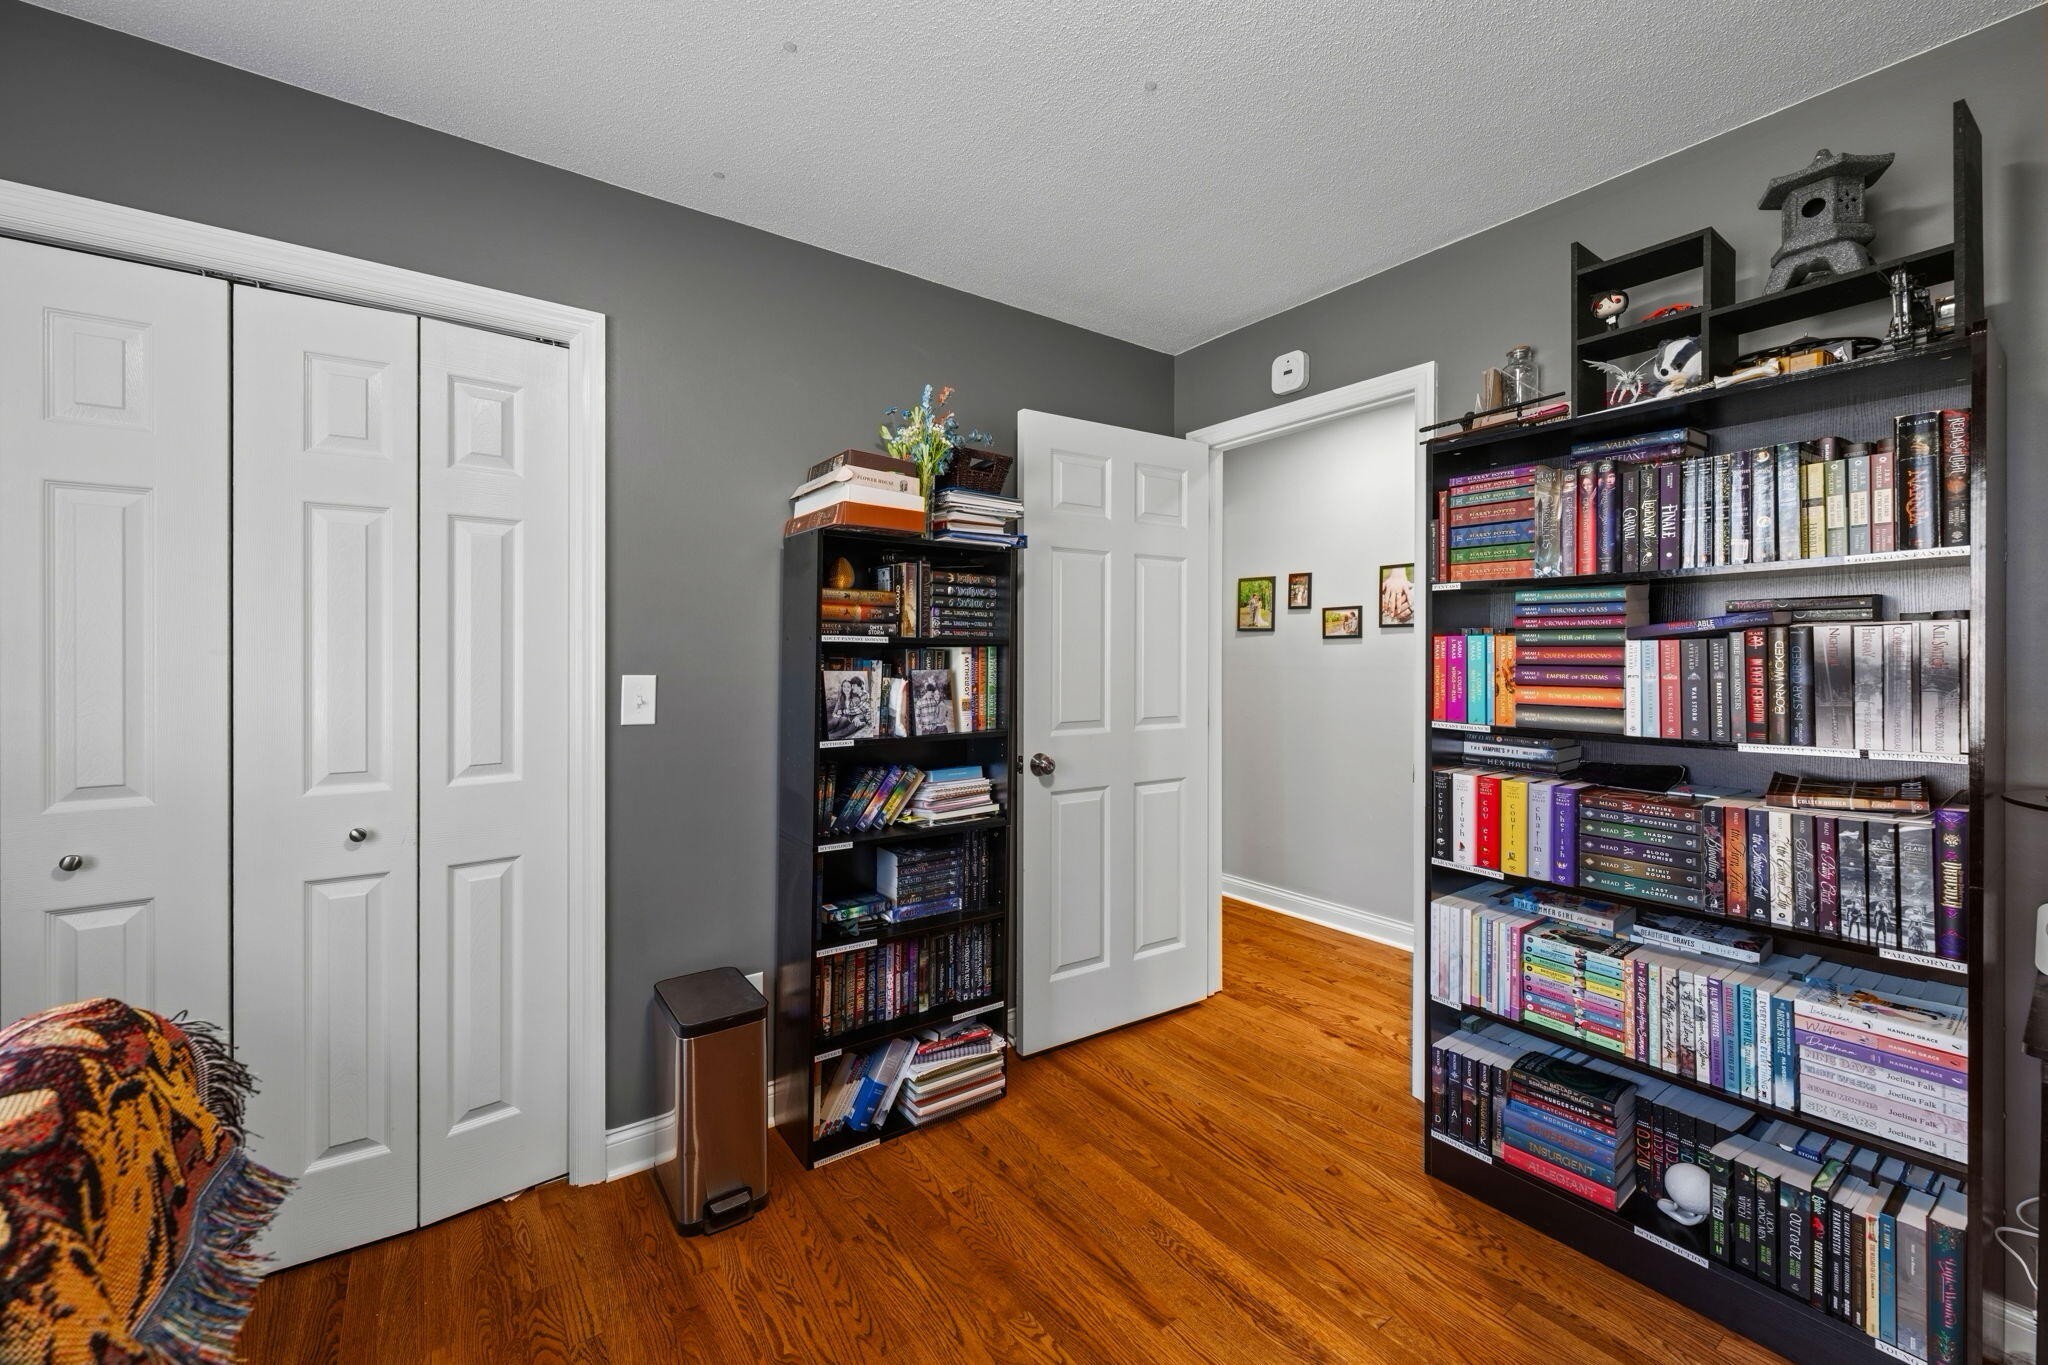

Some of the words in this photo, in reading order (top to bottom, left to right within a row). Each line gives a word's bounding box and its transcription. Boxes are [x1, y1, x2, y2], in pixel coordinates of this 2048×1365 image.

[1914, 417, 1936, 425] LEWIS
[1606, 438, 1646, 449] VALIANT
[1949, 454, 1966, 476] LIGHT
[1662, 504, 1678, 539] FINALE
[1775, 640, 1784, 687] WICKED
[1792, 645, 1802, 678] CURSED
[1775, 690, 1785, 715] BORN
[1793, 678, 1802, 709] STAR
[1482, 745, 1505, 753] VAMPIRE'S
[1508, 761, 1531, 769] HALL
[1638, 809, 1676, 817] ACADEMY
[1534, 807, 1542, 852] charm
[1640, 819, 1678, 828] FROSTBITE
[1644, 832, 1673, 840] SHADOW
[1643, 854, 1673, 862] PROMISE
[1642, 890, 1678, 900] SACRIFICE
[1530, 904, 1556, 915] SUMMER
[1558, 910, 1574, 920] GIRL
[1640, 928, 1670, 942] BEAUTIFUL
[1672, 937, 1696, 948] GRAVES
[1883, 950, 1964, 971] PARANORMAL
[1743, 998, 1752, 1020] STARTS
[1711, 1012, 1719, 1037] PERFECTS
[1743, 1022, 1752, 1037] WITH
[1776, 1009, 1785, 1036] ARCHER'S
[1888, 1027, 1915, 1039] HANNAH
[1917, 1035, 1939, 1044] GRACE
[1776, 1038, 1785, 1054] VOICE
[1888, 1044, 1916, 1055] HANNAH
[1918, 1051, 1940, 1061] GRACE
[1889, 1060, 1919, 1073] HANNAH
[1921, 1067, 1944, 1078] GRACE
[1887, 1073, 1916, 1086] Joelina
[1918, 1079, 1936, 1092] Falk
[1544, 1096, 1570, 1108] HUNGER
[1570, 1106, 1590, 1116] GAMES
[1888, 1089, 1917, 1103] Joelina
[1919, 1096, 1937, 1109] Falk
[1466, 1117, 1472, 1126] R
[1543, 1116, 1586, 1135] MOCKINGJAY
[1888, 1109, 1918, 1123] Joelina
[1919, 1115, 1938, 1129] Falk
[1888, 1127, 1917, 1142] Joelina
[1919, 1134, 1937, 1148] Falk
[1528, 1142, 1596, 1176] INSURGENT
[1758, 1196, 1766, 1224] AMONG
[1789, 1213, 1802, 1235] OUT
[1832, 1209, 1841, 1256] FRANKENSTEIN
[1789, 1245, 1802, 1260] OZ
[1814, 1240, 1823, 1268] GREGORY
[1814, 1268, 1823, 1296] MAGUIRE
